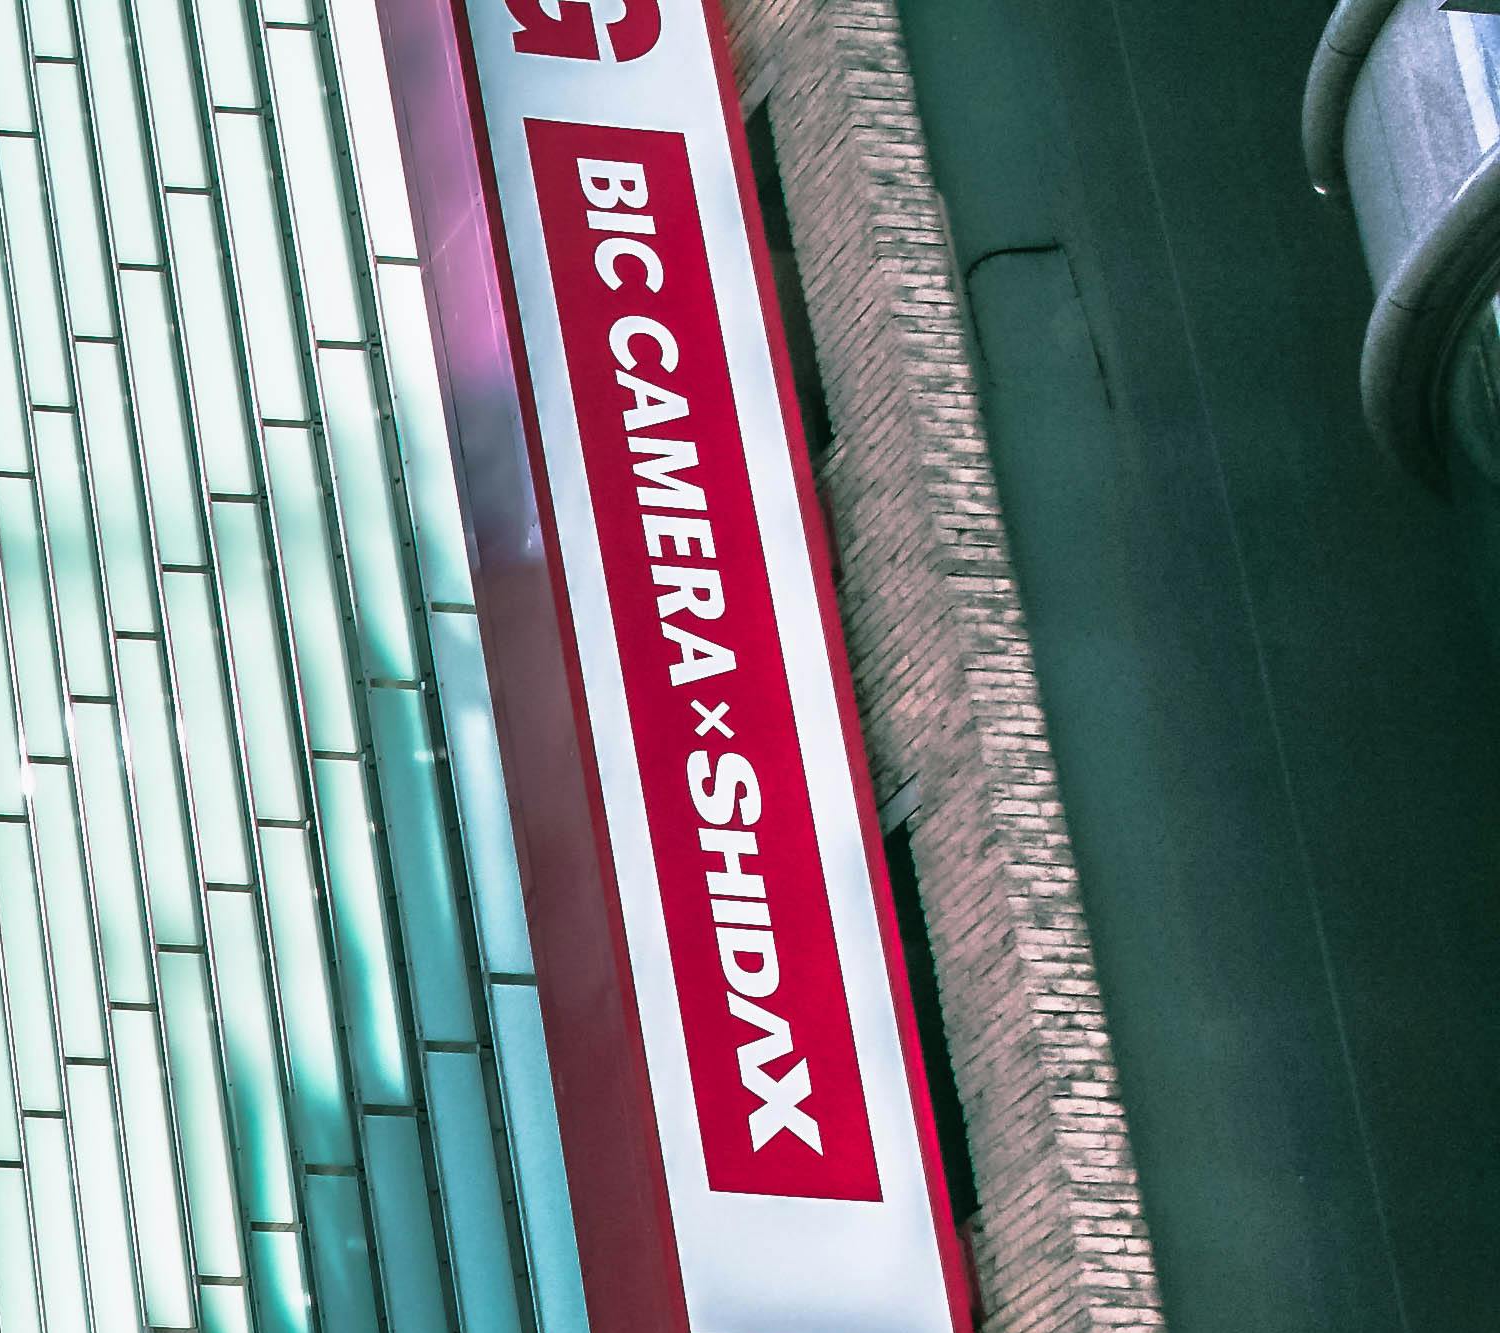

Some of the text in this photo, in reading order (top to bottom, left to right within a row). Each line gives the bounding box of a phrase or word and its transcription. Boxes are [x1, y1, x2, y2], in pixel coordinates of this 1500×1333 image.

[576, 157, 664, 294] BIC
[608, 315, 737, 687] CAMERA
[686, 750, 824, 1156] SHIDAX
